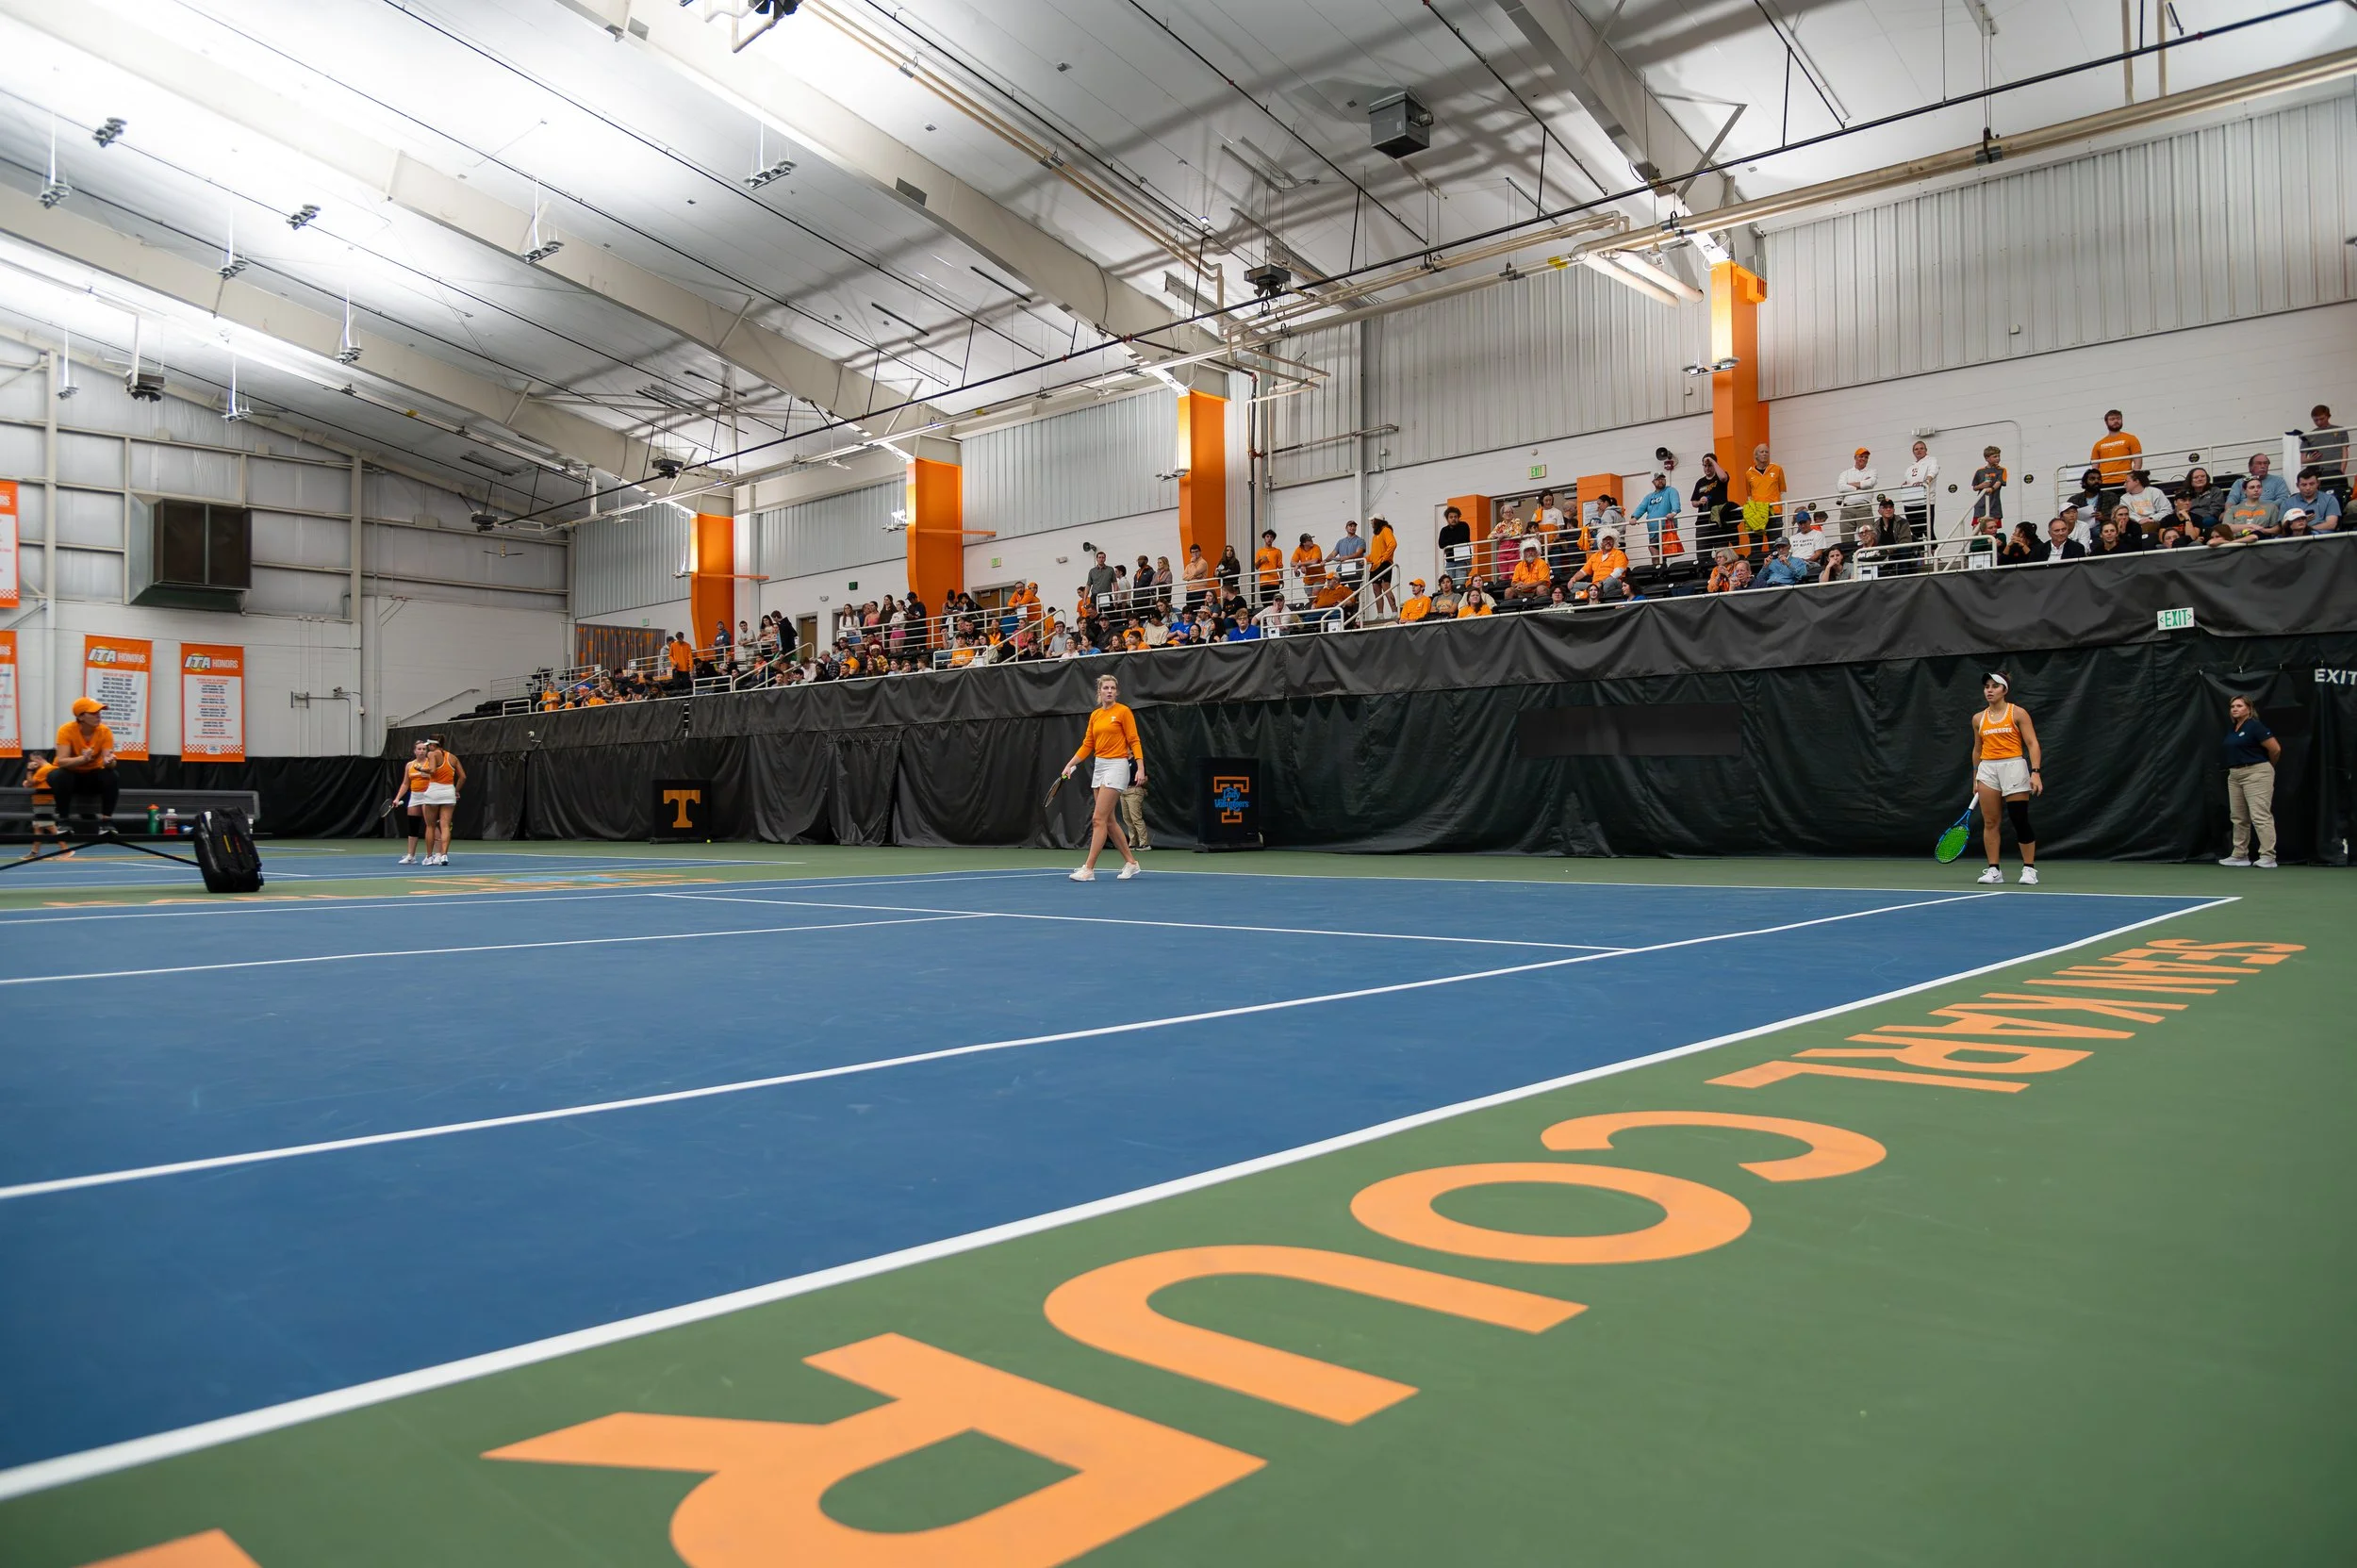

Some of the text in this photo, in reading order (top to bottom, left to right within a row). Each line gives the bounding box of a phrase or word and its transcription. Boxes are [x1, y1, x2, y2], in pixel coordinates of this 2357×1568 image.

[2165, 609, 2188, 627] EXIT
[88, 648, 146, 664] ITA HONORS
[184, 655, 239, 669] ITA HONORS
[2315, 668, 2357, 685] EXIT
[663, 789, 701, 828] T
[83, 938, 2306, 1568] SEAN KARL COUR
